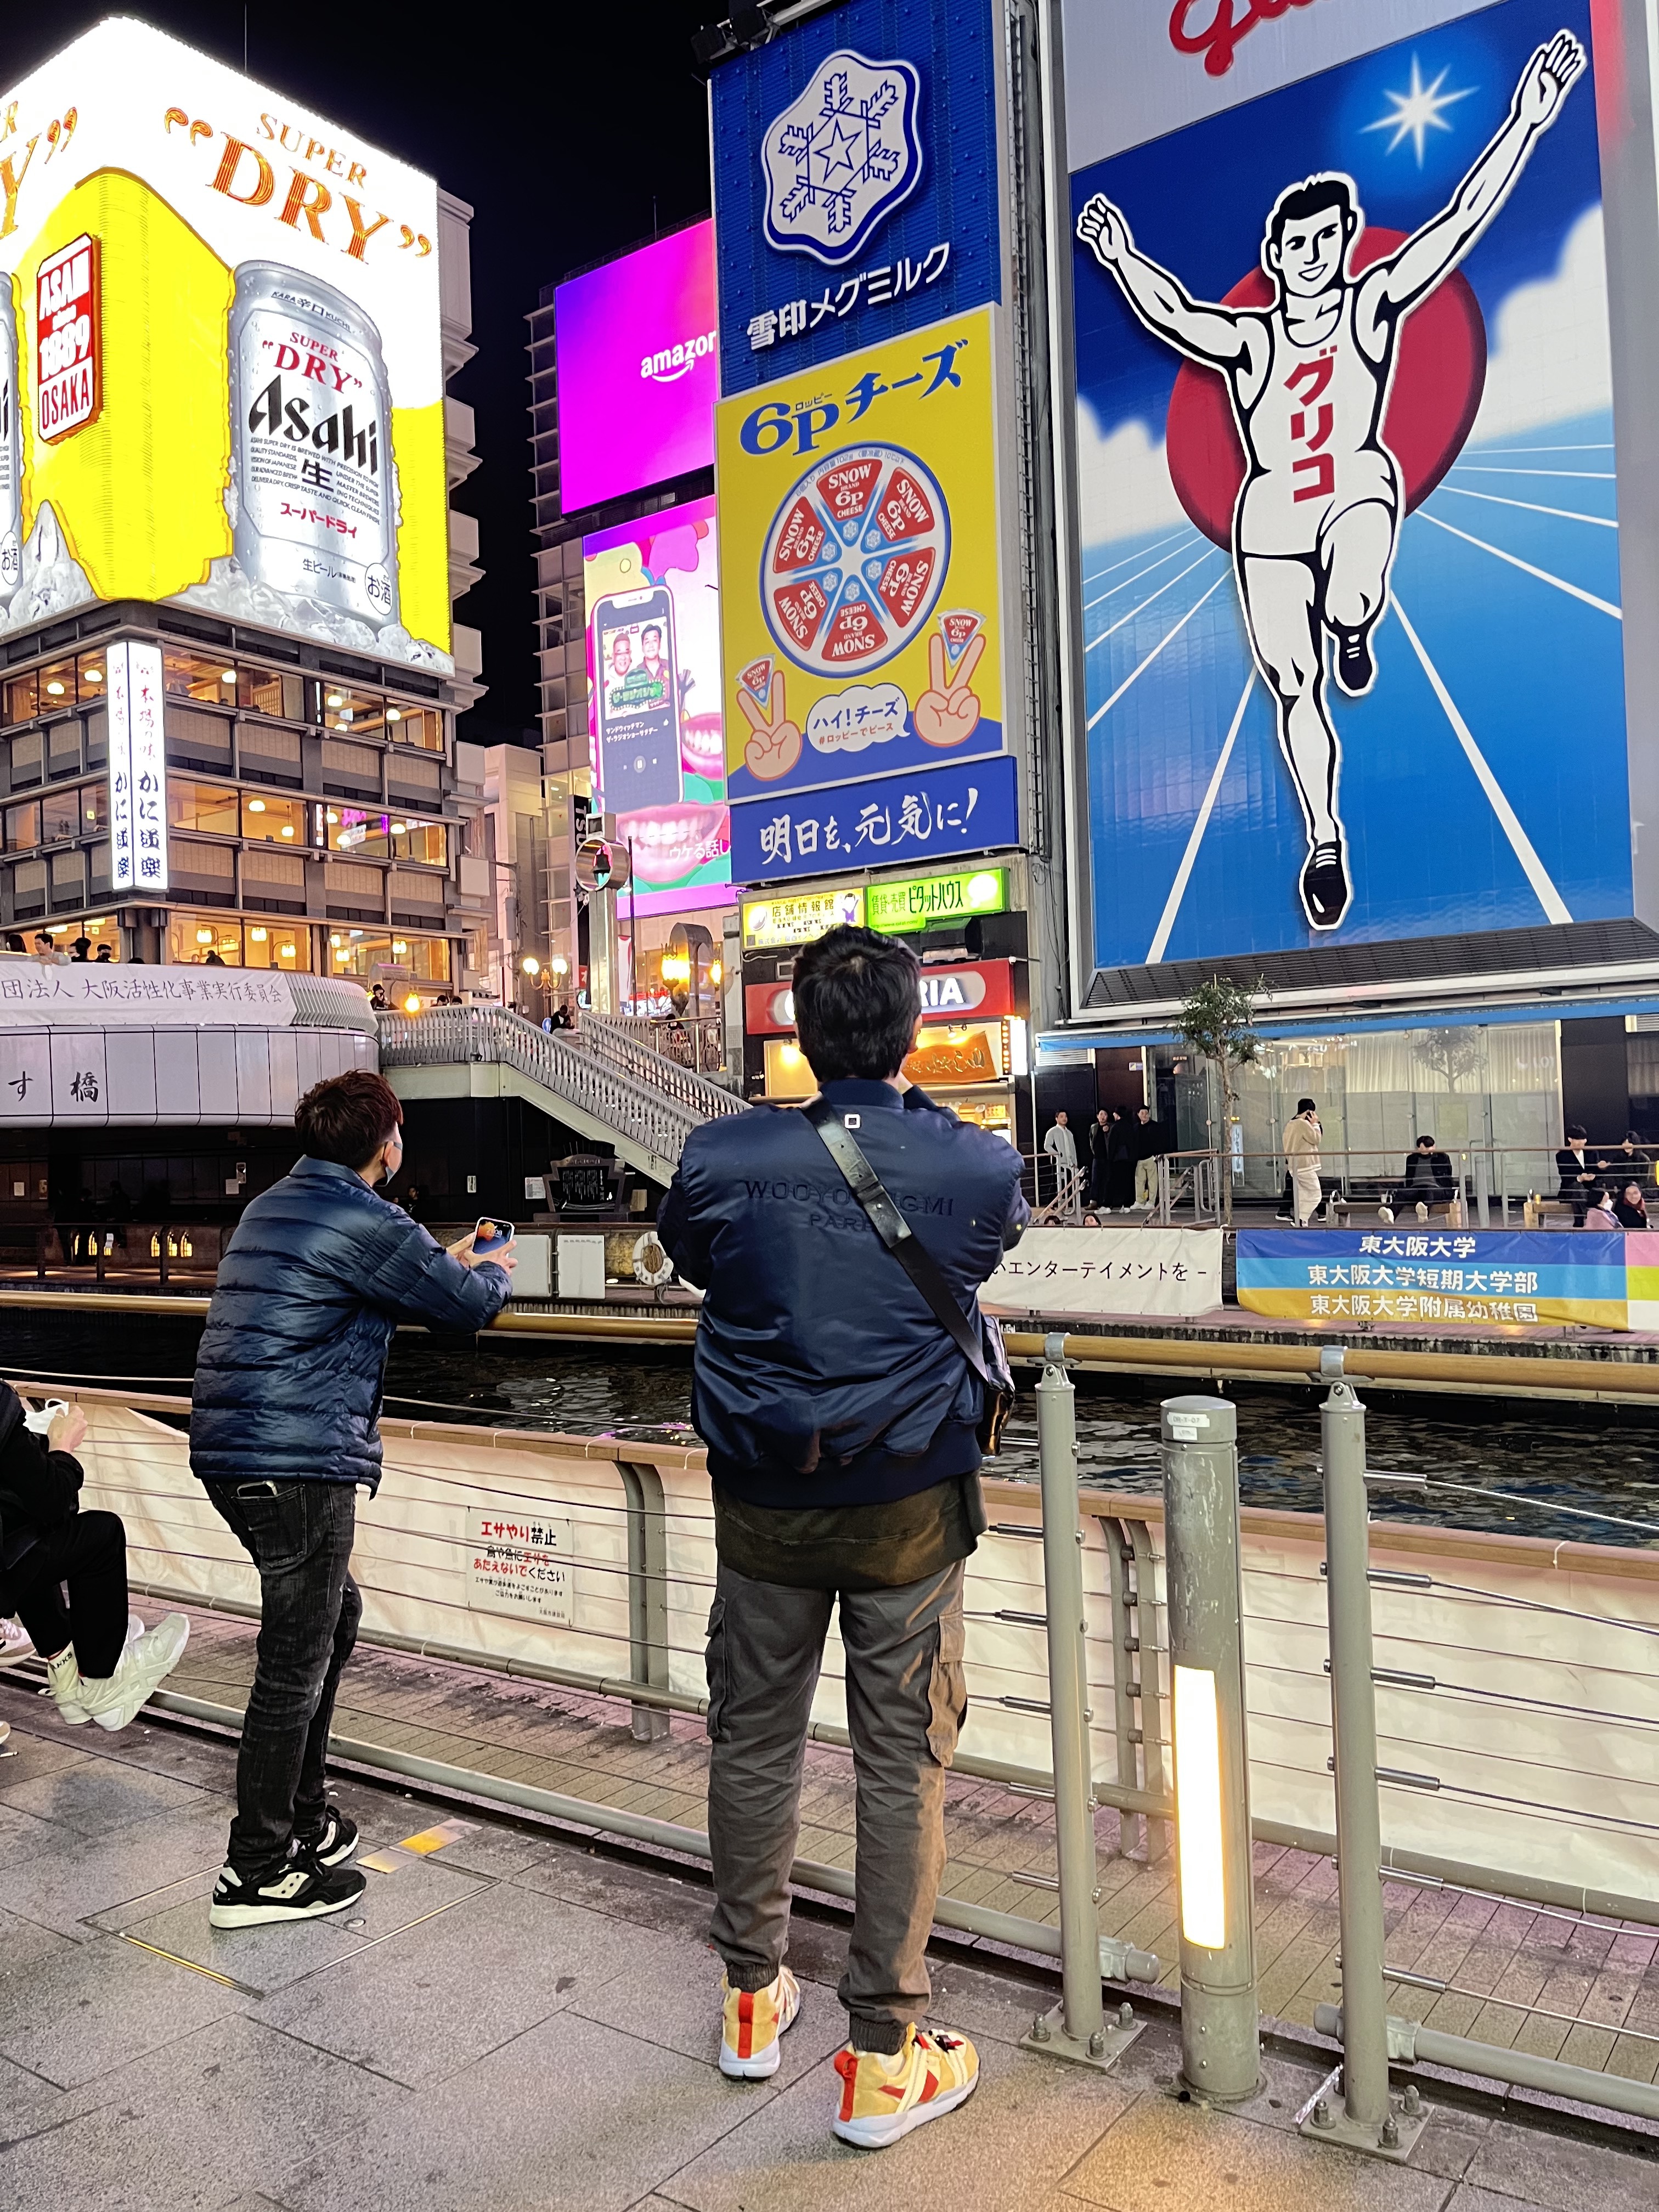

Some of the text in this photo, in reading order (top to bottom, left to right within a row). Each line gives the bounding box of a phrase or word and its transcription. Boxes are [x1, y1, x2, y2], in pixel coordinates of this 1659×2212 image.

[257, 112, 367, 190] SUPER
[747, 242, 950, 351] 雪印メグミルク
[271, 291, 295, 303] KARA
[325, 311, 351, 332] KUCHI
[39, 314, 90, 381] 1889
[290, 332, 338, 362] SUPER
[42, 368, 90, 430] OSAKA
[795, 393, 832, 411] ロッピー
[247, 374, 379, 476] Asahi
[297, 447, 320, 459] BREWED
[321, 454, 336, 466] WITH
[337, 461, 362, 478] PRECISION
[301, 458, 334, 493] 生
[336, 469, 355, 484] UNDER
[828, 464, 872, 489] SNOW
[301, 486, 318, 496] TASTE
[318, 492, 332, 501] AND
[336, 481, 359, 495] MASTER
[839, 481, 860, 492] BRAND
[896, 478, 929, 523] SNOW
[280, 502, 358, 539] スーパードライ
[837, 505, 863, 519] CHEESE
[877, 512, 896, 540] CHEESE
[779, 508, 805, 562] SNOW
[808, 530, 824, 562] CHEESE
[367, 575, 391, 606] お酒
[879, 560, 897, 592] CHEESE
[900, 560, 929, 616] SNOW
[809, 581, 826, 608] CHEESE
[778, 596, 808, 640] SNOW
[840, 603, 867, 617] CHEESE
[949, 618, 973, 627] SNOW
[831, 634, 876, 657] SNOW
[747, 663, 765, 680] SNOW
[819, 722, 893, 746] #ロッピーでピース
[872, 881, 963, 915] 賃貸・売買 ピタットハウス
[82, 977, 283, 1004] 大阪活性化事業実行委員会
[744, 1180, 955, 1216] WOOYOGMI
[809, 1214, 873, 1232] PARI
[1358, 1234, 1477, 1259] 東大阪大学
[1307, 1264, 1538, 1294] 東大阪大学短期大学部
[1310, 1294, 1539, 1323] 東大阪大学附属幼稚園
[481, 1521, 557, 1546] エサやり禁止
[473, 1558, 565, 1582] あたえないでください
